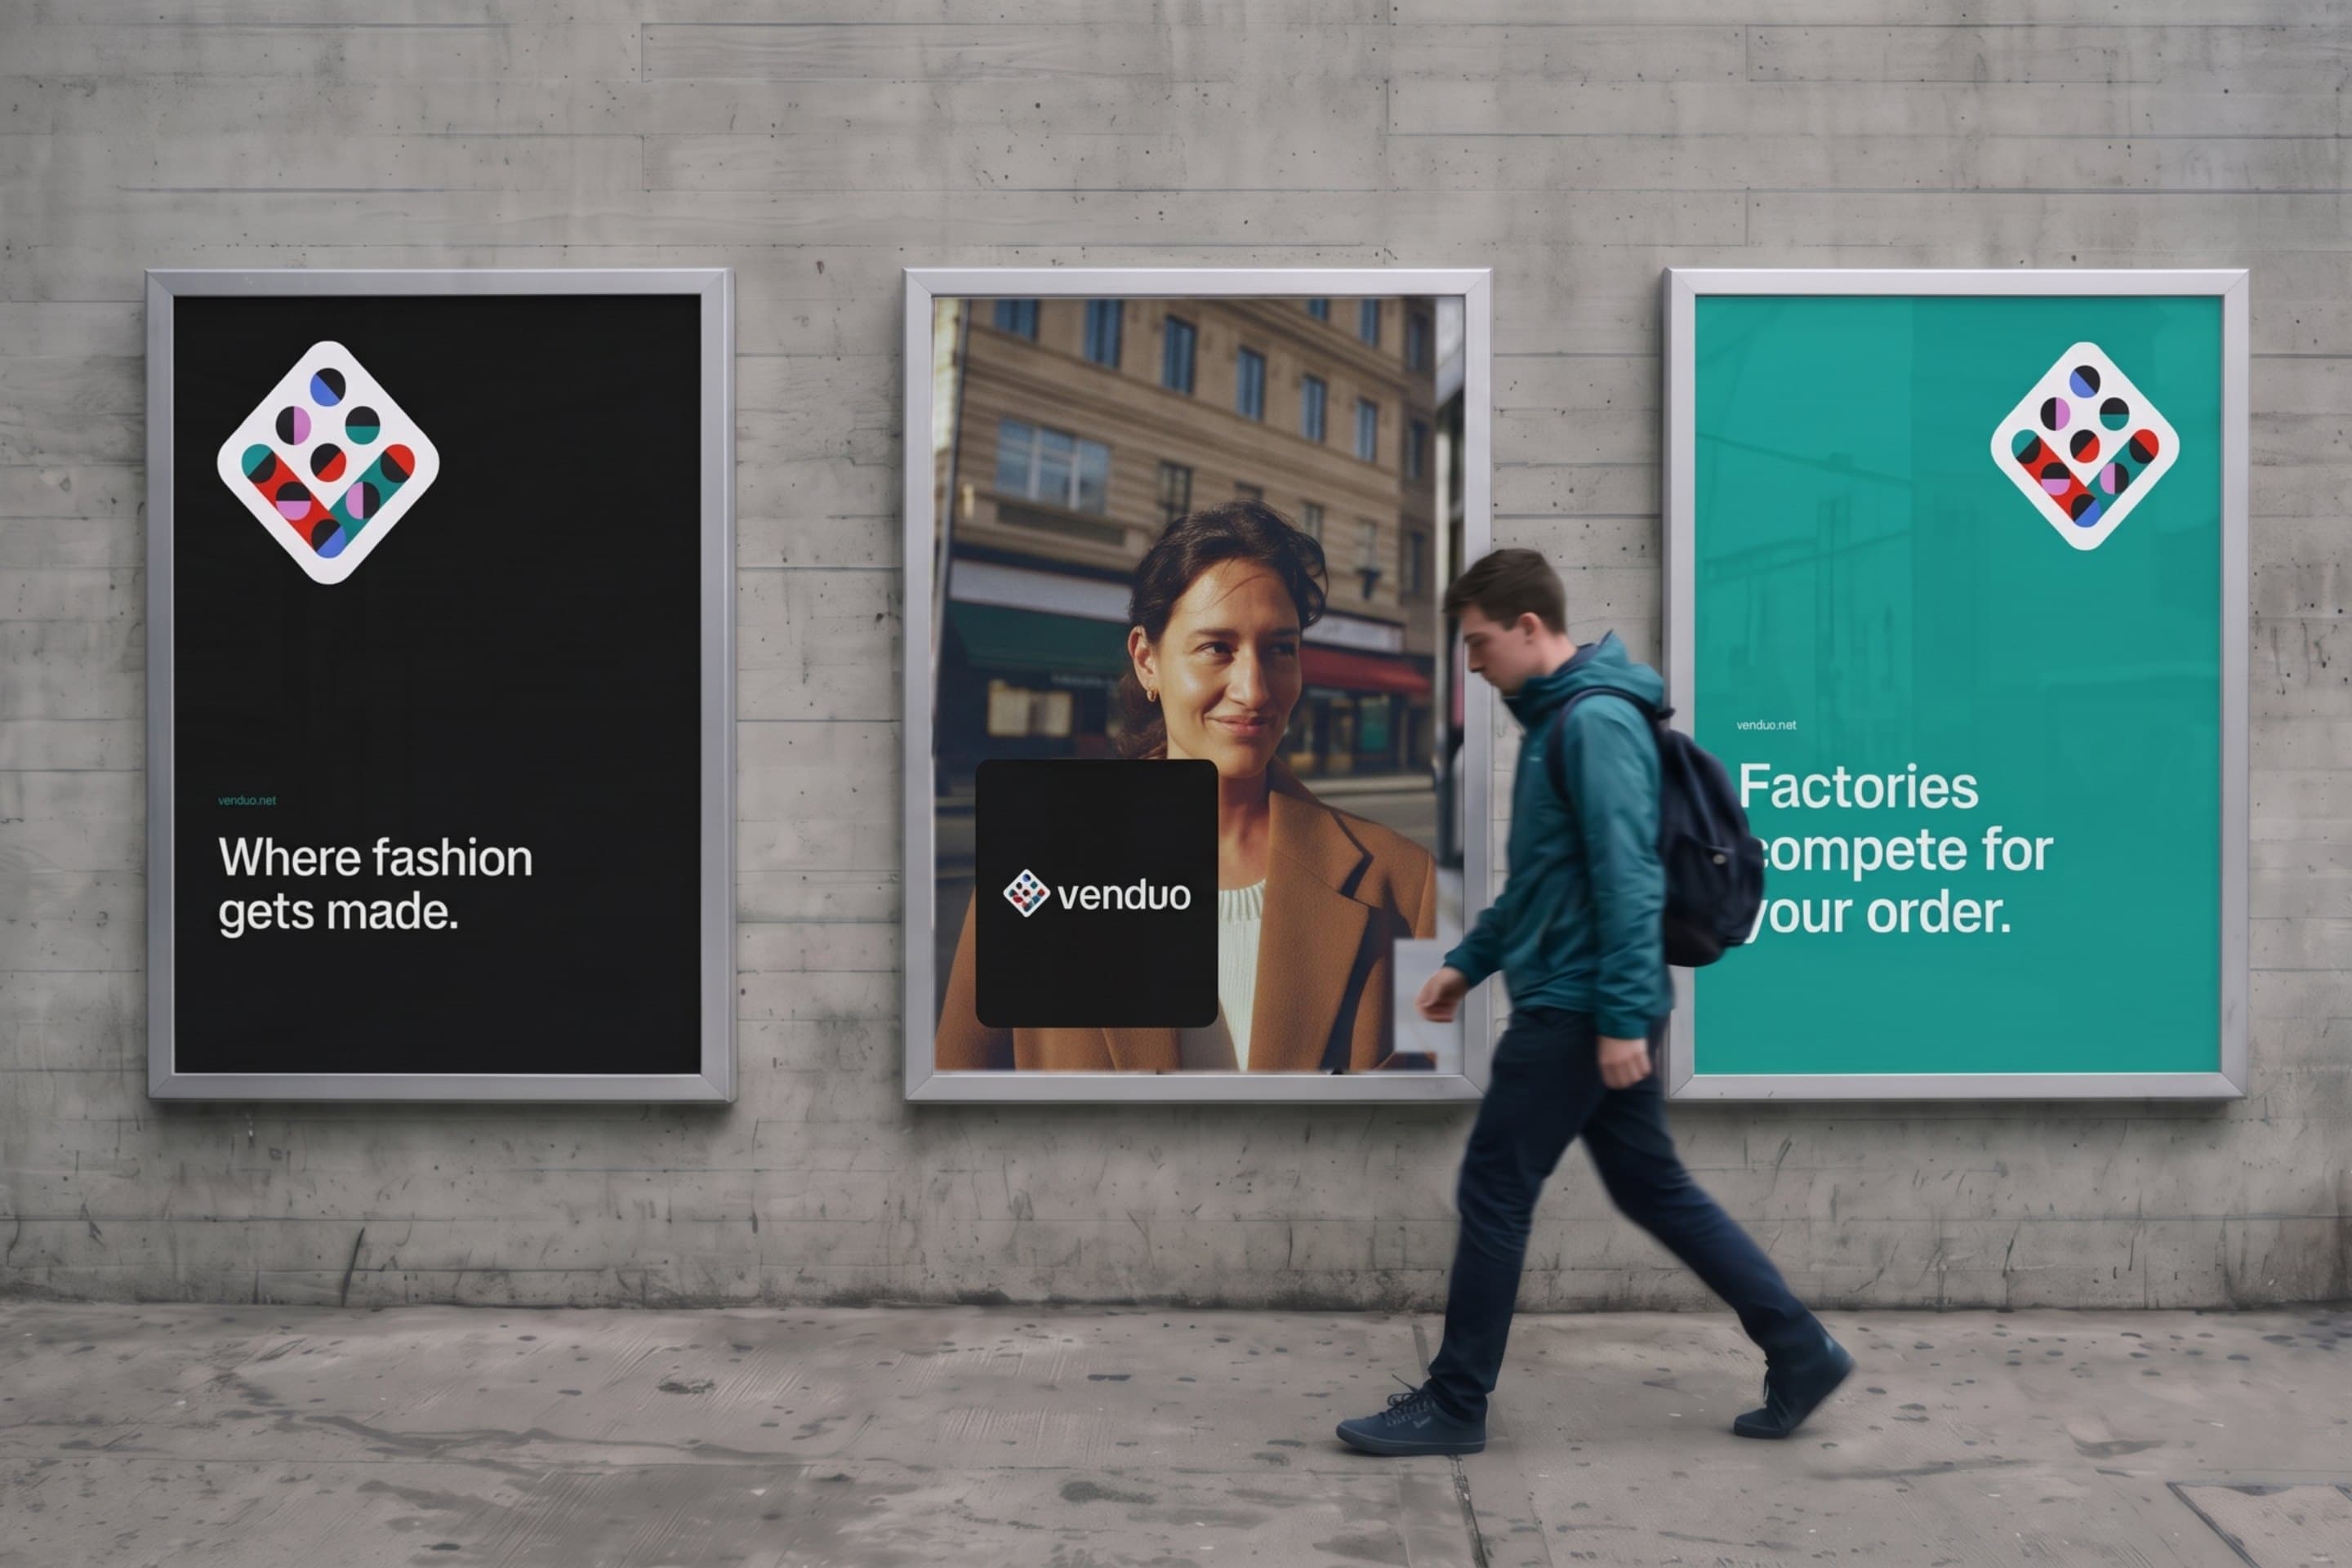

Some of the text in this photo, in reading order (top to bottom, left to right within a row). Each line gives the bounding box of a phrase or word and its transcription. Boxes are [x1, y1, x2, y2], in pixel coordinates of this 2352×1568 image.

[1736, 719, 1797, 731] venduo.net
[217, 795, 277, 806] venduo.net
[1740, 762, 1980, 809] Factories
[218, 836, 532, 877] Where fashion
[1758, 825, 2055, 882] ompete for
[219, 890, 458, 939] gets made.
[1057, 877, 1192, 911] venduo
[1867, 888, 2011, 933] order.
